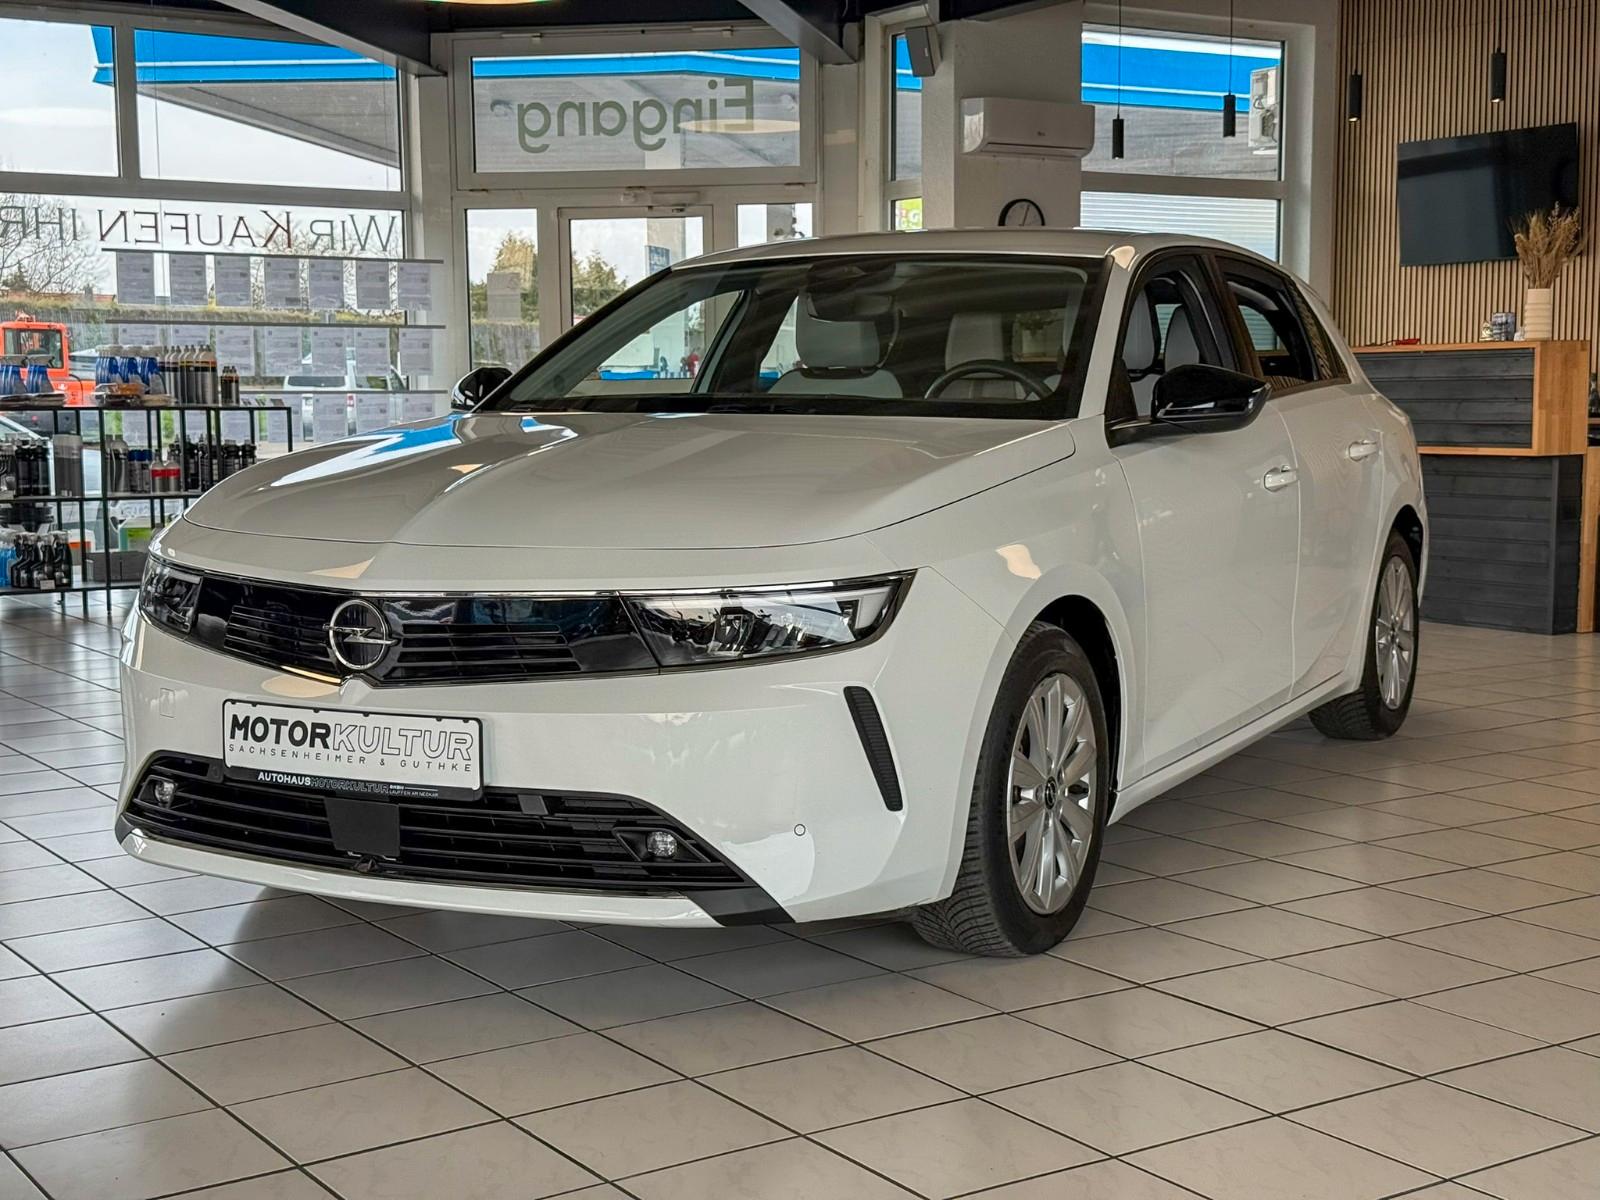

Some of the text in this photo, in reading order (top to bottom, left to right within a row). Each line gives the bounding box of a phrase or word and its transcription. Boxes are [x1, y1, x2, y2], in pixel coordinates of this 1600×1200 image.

[229, 713, 473, 761] MOTORKULTUR
[229, 743, 472, 773] SACHSENHEIMER & GUTHKE
